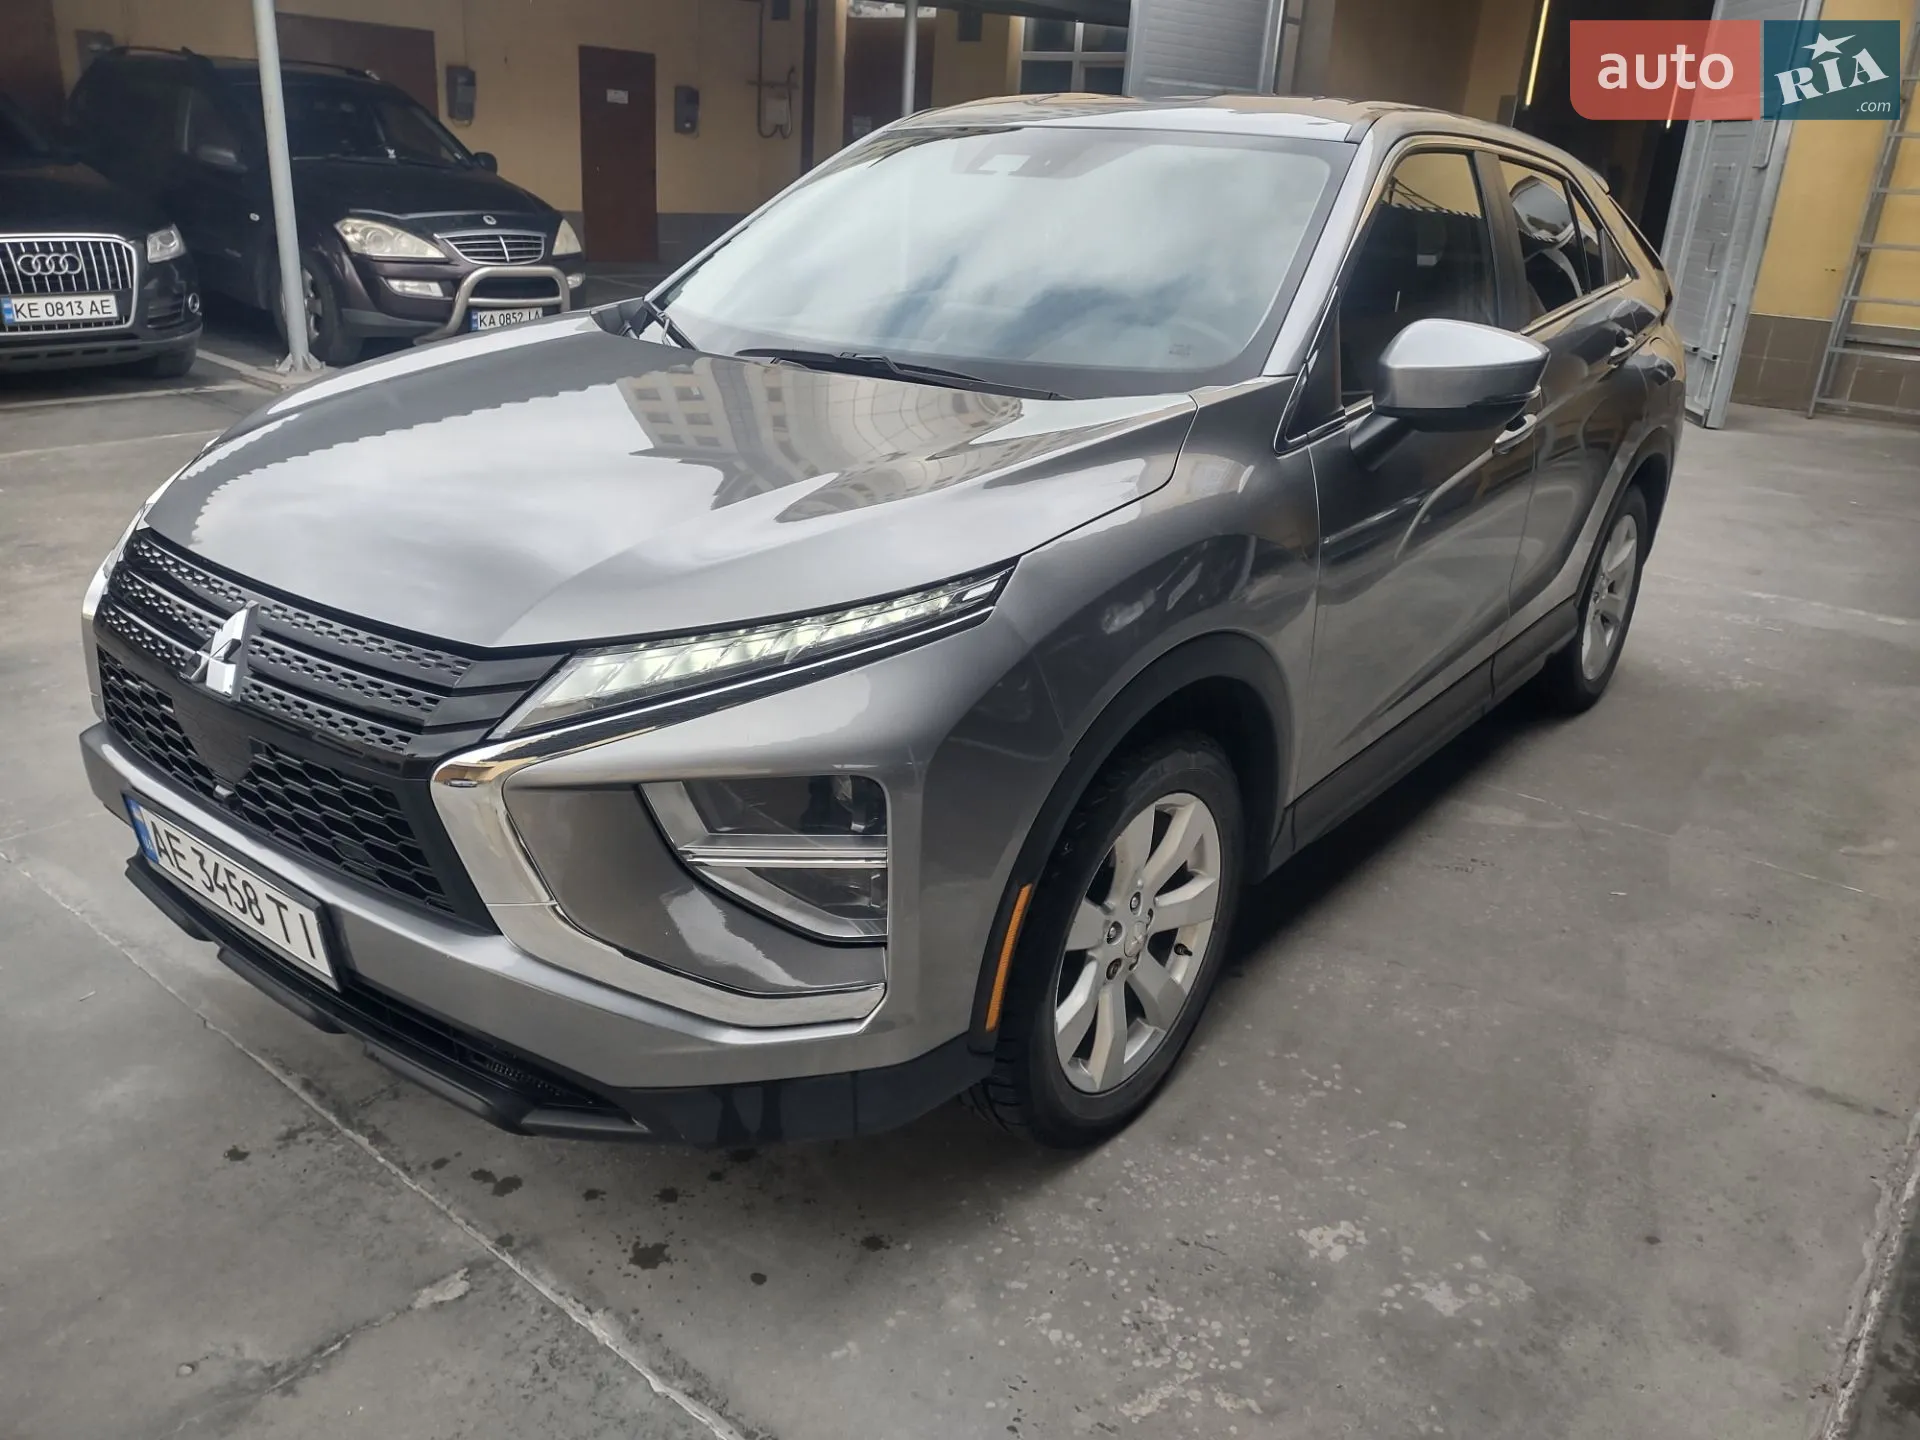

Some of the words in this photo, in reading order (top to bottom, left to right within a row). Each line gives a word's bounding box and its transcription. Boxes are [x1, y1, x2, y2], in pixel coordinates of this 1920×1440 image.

[14, 303, 40, 319] KE
[44, 301, 83, 316] 0813
[89, 299, 113, 315] AE
[479, 314, 496, 328] KA
[498, 312, 524, 326] 0852
[150, 820, 194, 880] AE
[190, 846, 265, 926] 3458
[265, 892, 316, 959] TI
